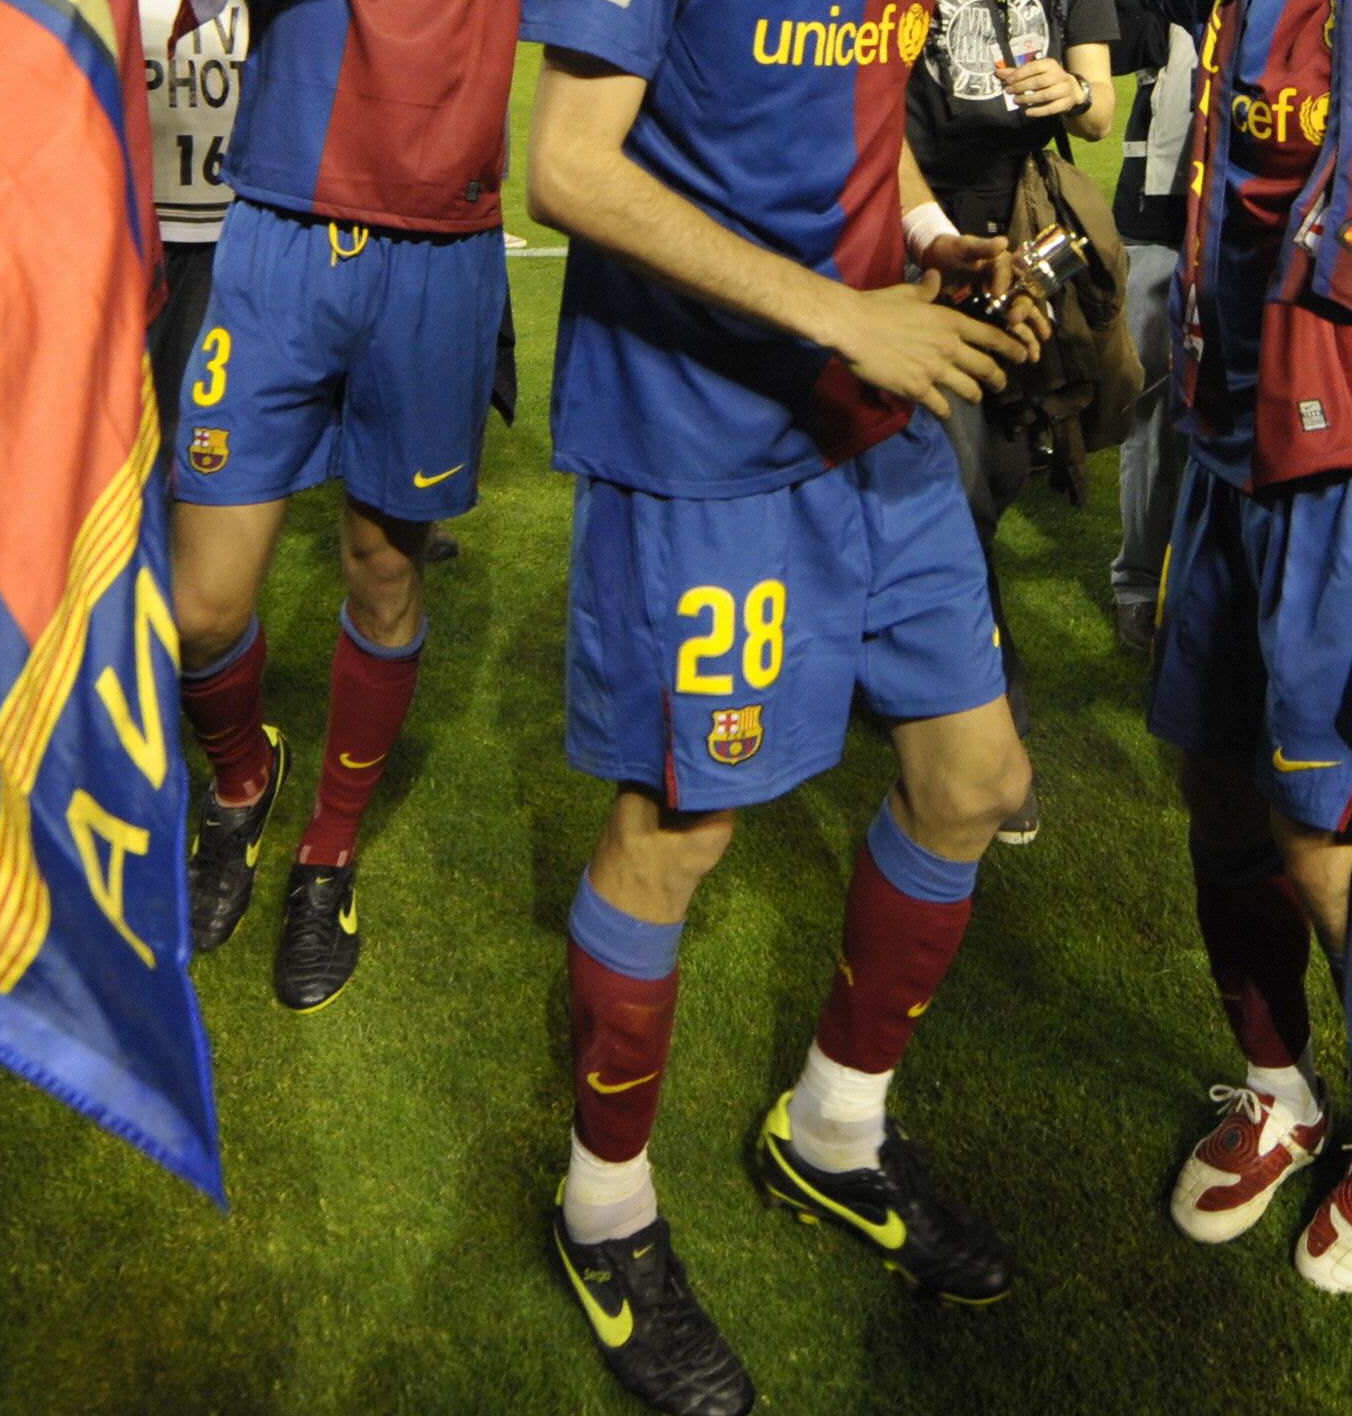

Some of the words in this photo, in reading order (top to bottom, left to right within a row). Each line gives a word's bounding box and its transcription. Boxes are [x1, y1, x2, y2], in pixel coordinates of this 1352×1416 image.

[753, 3, 896, 67] unicef
[176, 135, 225, 186] 16
[192, 327, 232, 407] 3
[676, 578, 786, 696] 28
